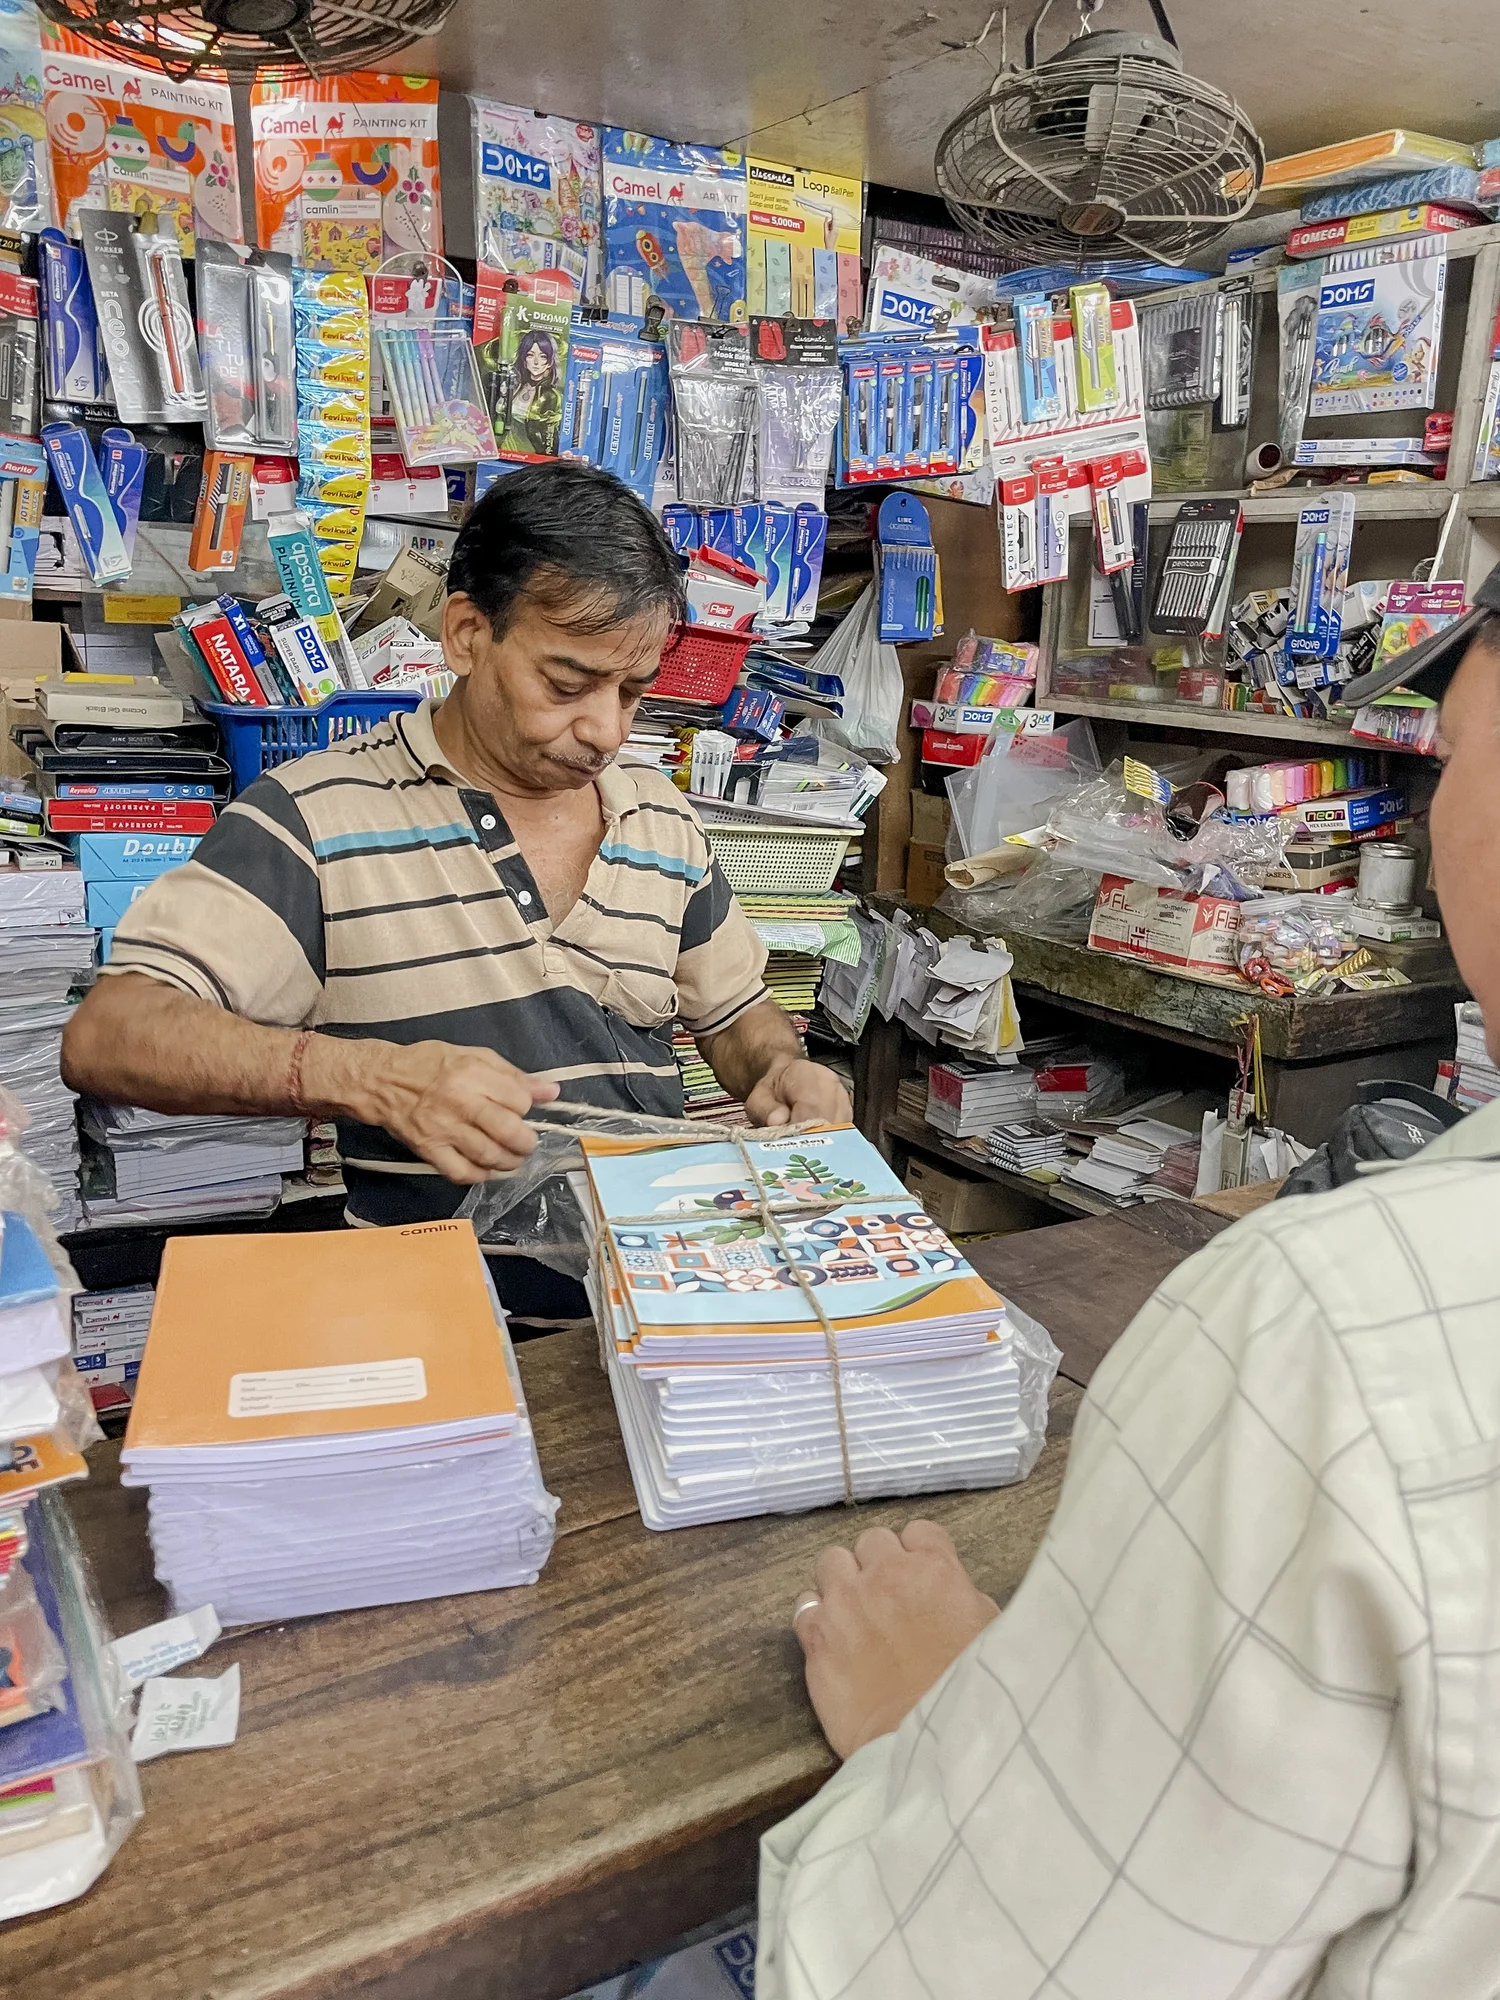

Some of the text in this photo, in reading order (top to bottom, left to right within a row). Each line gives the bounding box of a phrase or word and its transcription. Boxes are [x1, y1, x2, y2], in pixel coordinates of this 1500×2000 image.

[44, 65, 114, 95] Camel
[151, 88, 223, 112] PAINTING KIT
[261, 115, 318, 134] Camel
[353, 118, 427, 128] PAINTING KIT
[486, 148, 547, 183] DOMS
[751, 168, 794, 184] classmate
[612, 176, 738, 204] Camel ART KIT
[803, 177, 854, 198] Loop Ball Pen
[306, 204, 339, 214] camlin
[1301, 227, 1345, 245] OMEGA
[479, 297, 497, 306] FREE
[1322, 283, 1374, 305] DOMS
[517, 305, 569, 326] K-DRAMA
[988, 361, 999, 423] POINTEC
[610, 417, 621, 455] JETTER
[644, 422, 655, 461] JETTER
[5, 463, 33, 474] Rorito
[232, 471, 242, 501] JOTTEK
[20, 489, 30, 522] JOTTEK
[1302, 511, 1328, 522] DOMS
[1006, 514, 1014, 571] POINTEC
[408, 551, 444, 576] DOMS
[1172, 560, 1206, 568] pentonic
[276, 546, 302, 609] PLATINUM
[289, 541, 321, 607] apsara
[710, 603, 732, 615] Flair
[233, 614, 245, 630] X1
[281, 637, 301, 674] SUPER DARK
[298, 628, 326, 671] DOMS
[85, 705, 106, 713] Black
[964, 712, 993, 722] DOMS
[69, 787, 97, 795] Reynolds
[1306, 809, 1346, 821] neon
[112, 821, 164, 829] PAPERSOFT
[123, 839, 195, 856] Doubl
[400, 1224, 458, 1236] camlin
[86, 1315, 110, 1324] Camel
